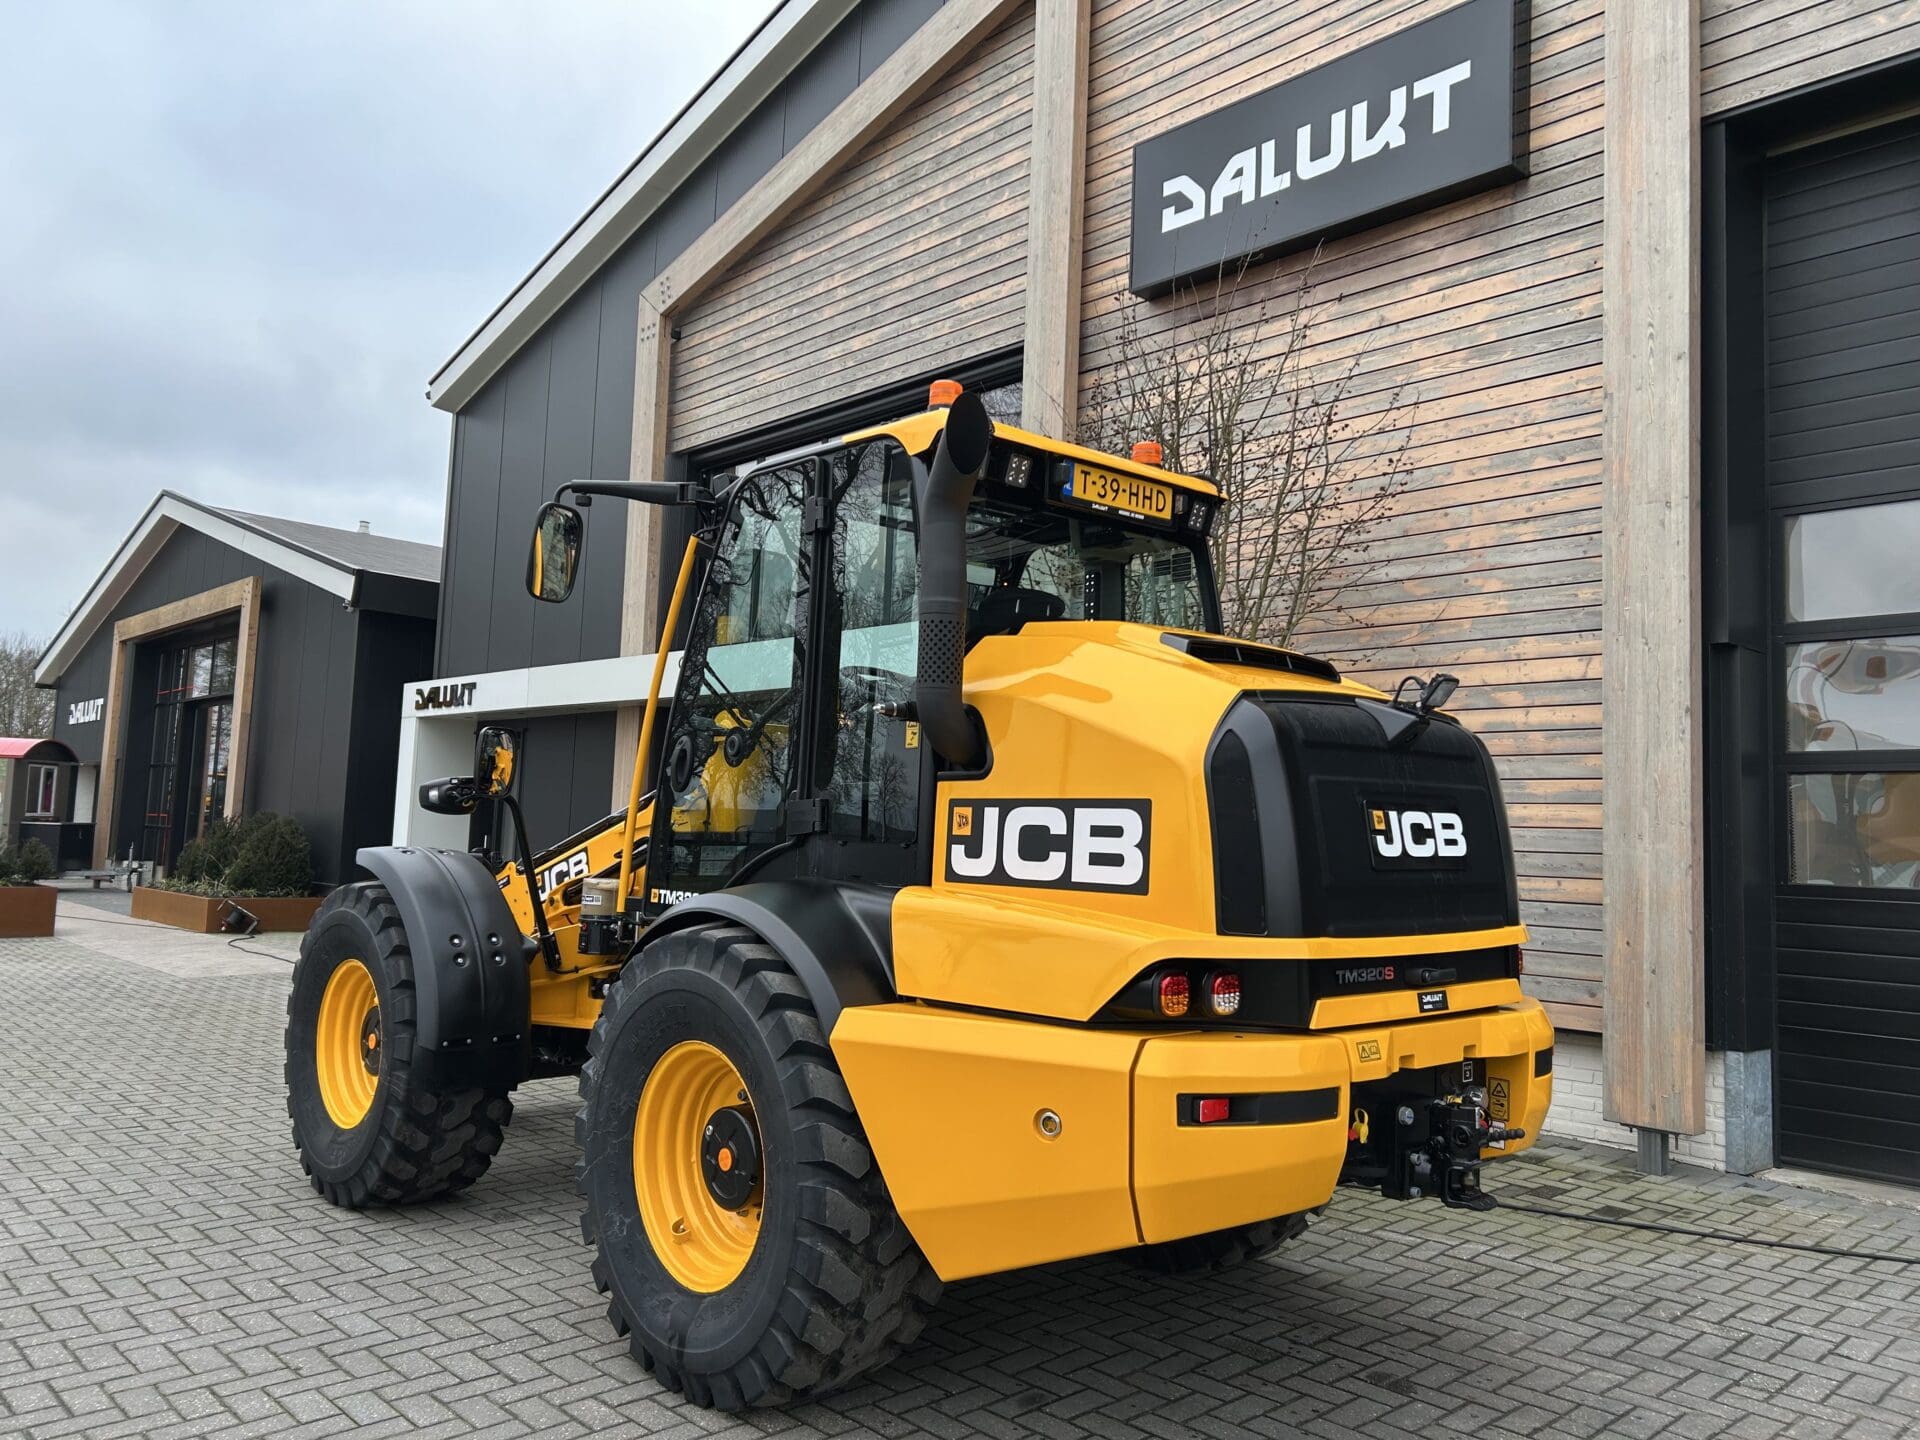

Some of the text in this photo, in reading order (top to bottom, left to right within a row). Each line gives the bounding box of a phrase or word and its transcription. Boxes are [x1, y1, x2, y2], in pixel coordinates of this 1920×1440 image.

[1080, 469, 1167, 513] T-39-HHD
[950, 806, 1144, 886] JCB
[1375, 810, 1468, 858] JCB
[538, 851, 589, 902] JCB
[1335, 966, 1395, 985] TM320S
